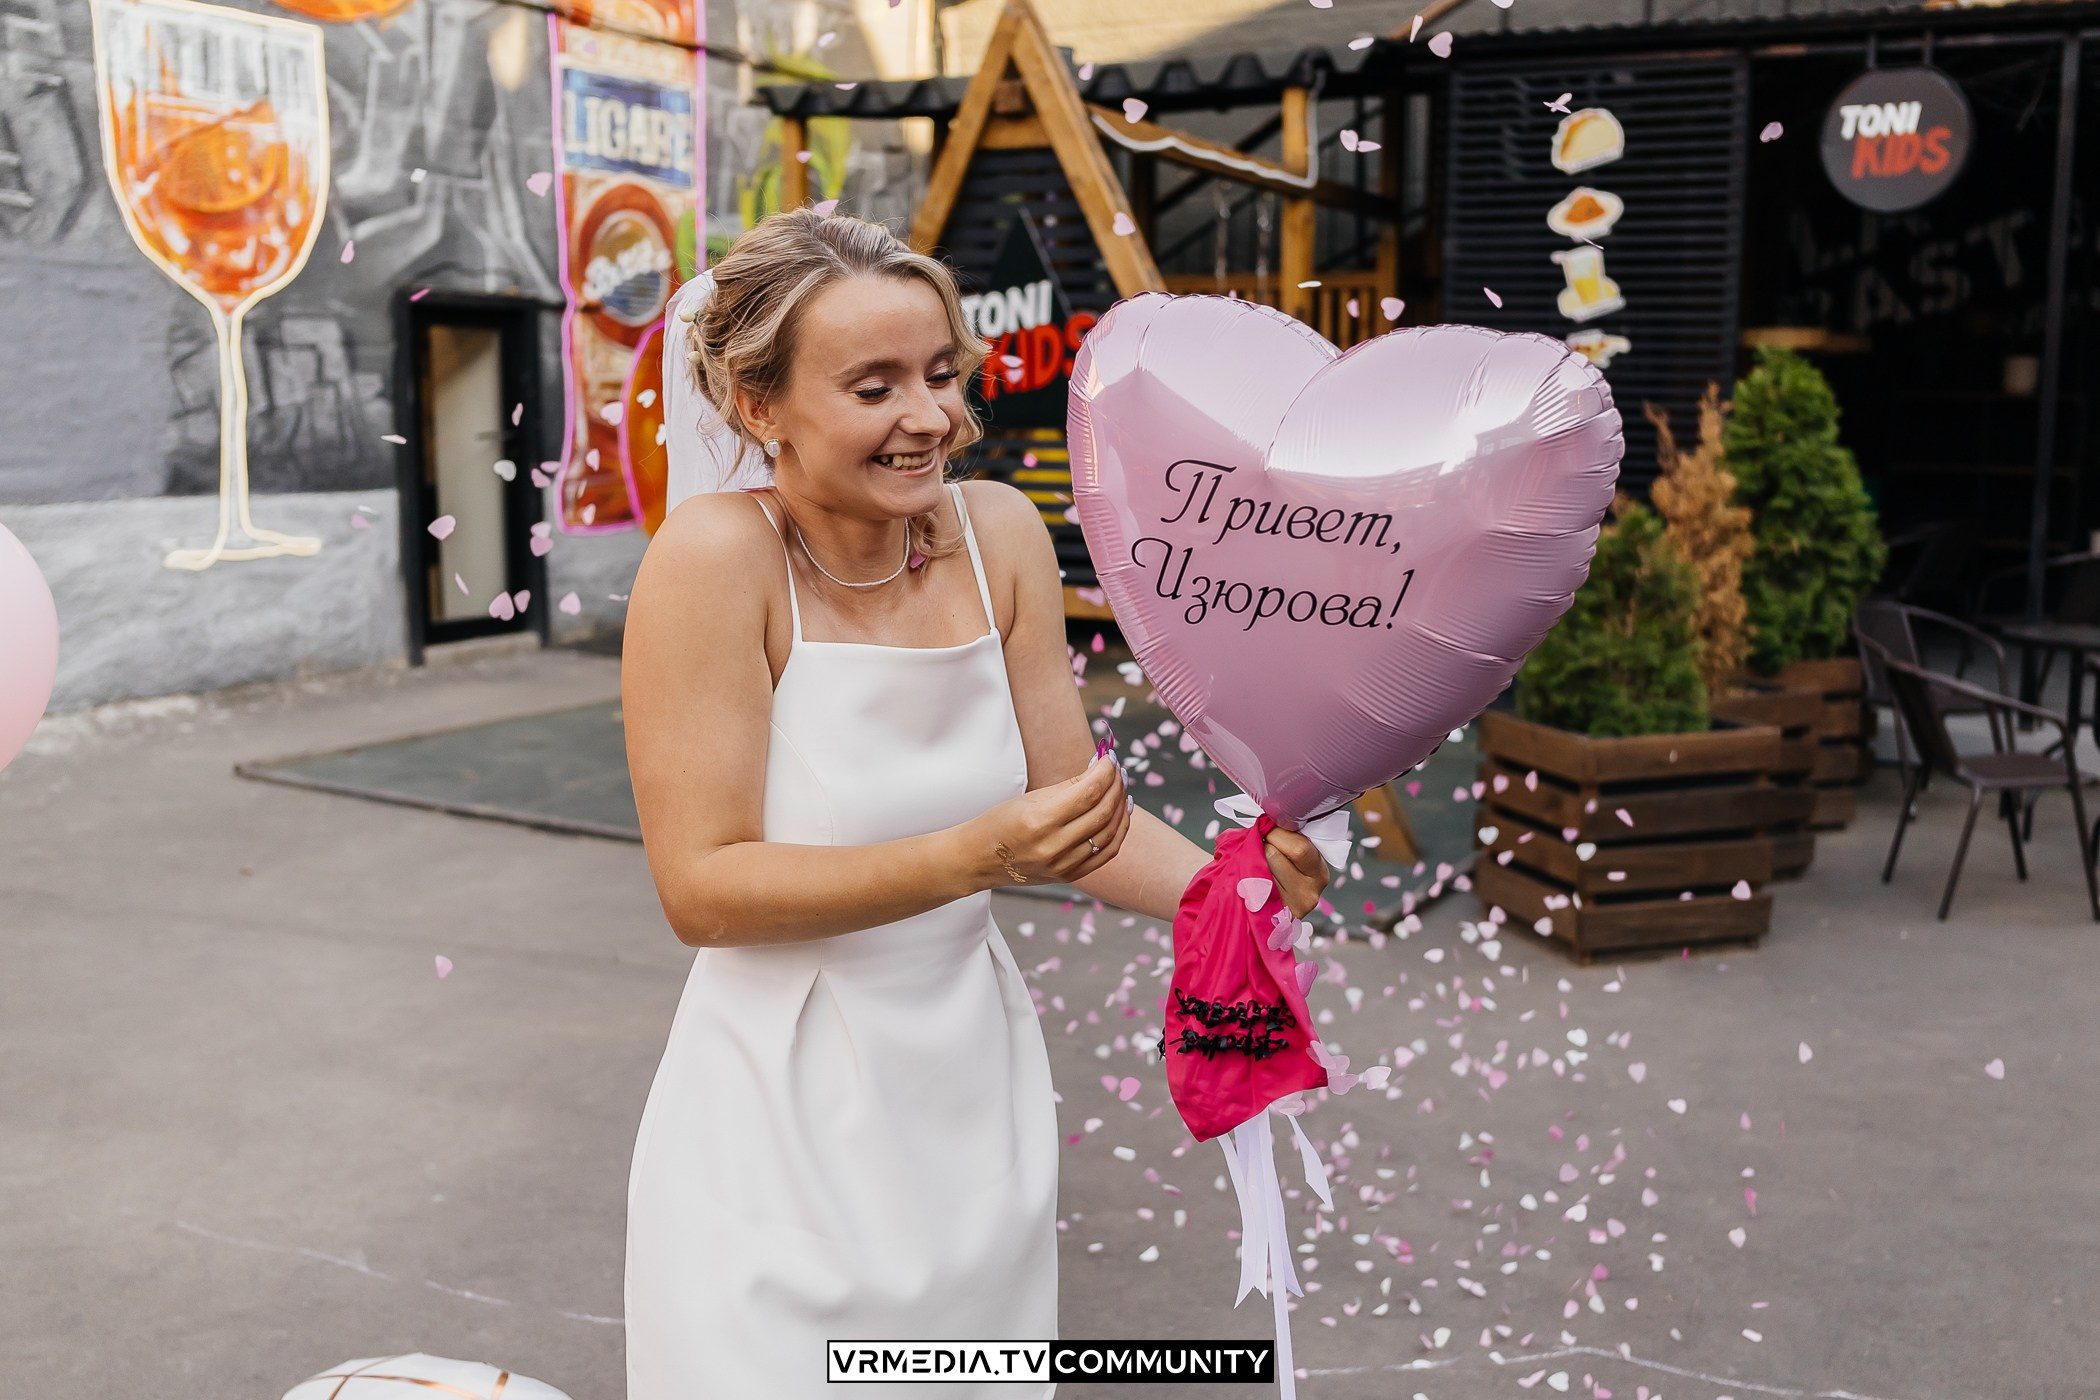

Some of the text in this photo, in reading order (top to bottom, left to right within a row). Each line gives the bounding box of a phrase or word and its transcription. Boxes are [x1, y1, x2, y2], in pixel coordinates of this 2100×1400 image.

[1839, 101, 1922, 141] TONI
[1852, 125, 1952, 180] KIDS
[960, 279, 1052, 338] TONI
[982, 311, 1097, 400] KIDS
[1160, 459, 1401, 555] Привет,
[1131, 537, 1415, 632] Изюрова!
